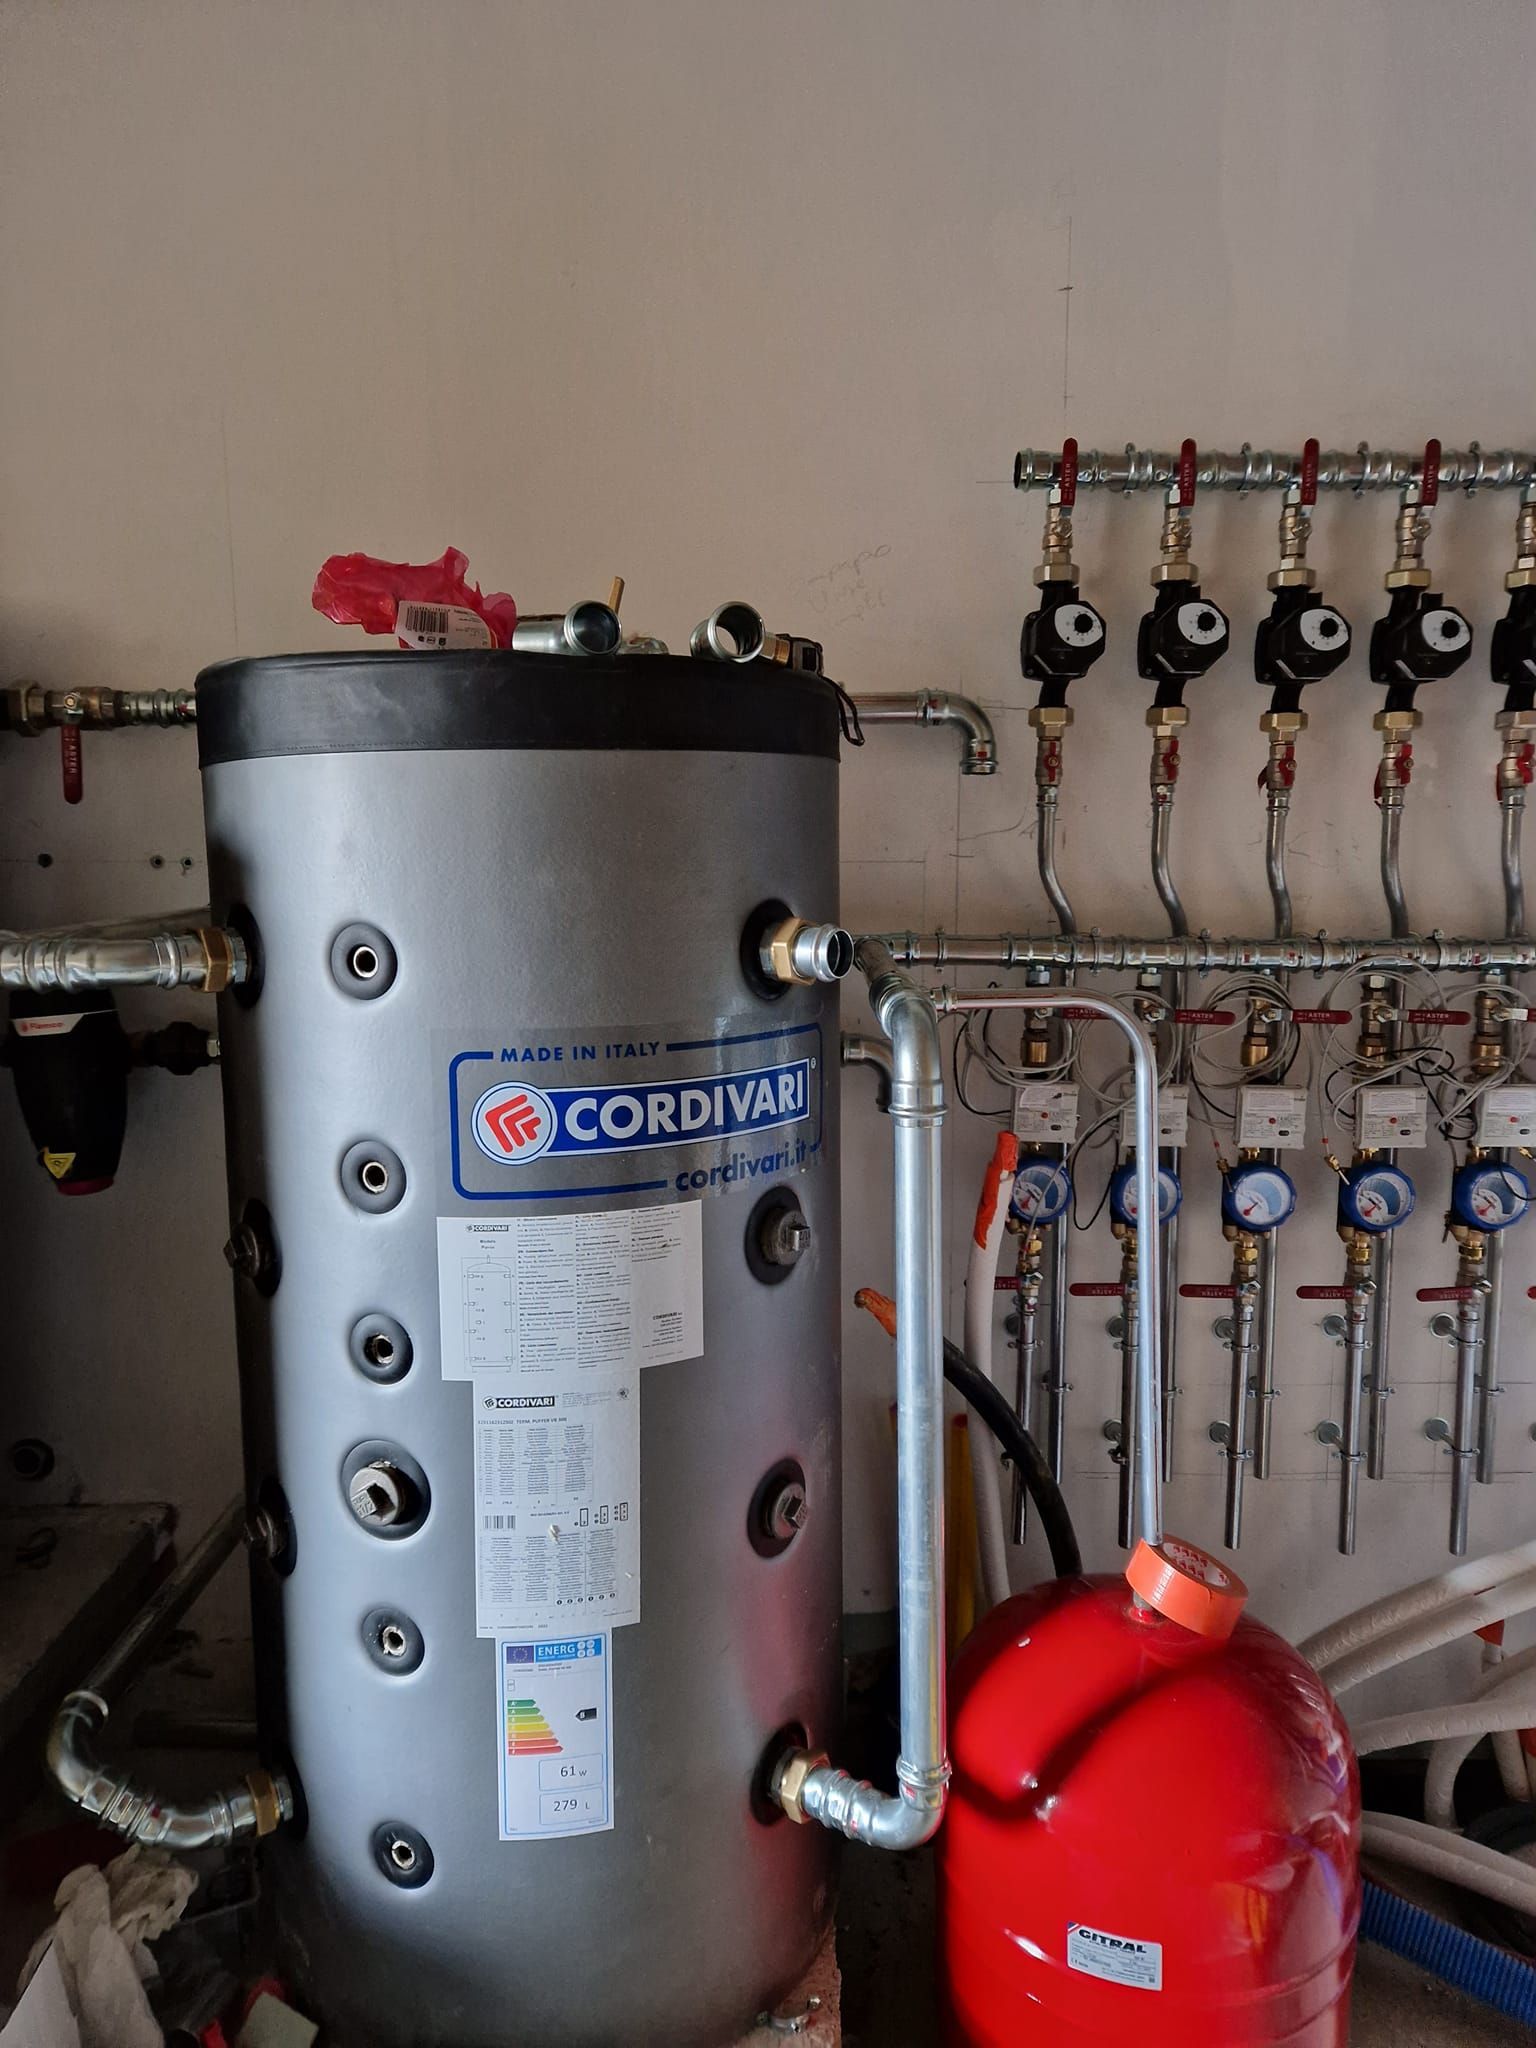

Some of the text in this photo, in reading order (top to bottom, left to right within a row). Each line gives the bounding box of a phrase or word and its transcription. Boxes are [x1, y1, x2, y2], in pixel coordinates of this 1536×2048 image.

[500, 1042, 660, 1062] MADE IN ITALY
[564, 1070, 804, 1141] CORDIVARI
[675, 1142, 807, 1192] cordivari.it
[498, 1397, 553, 1408] CORDIVARI
[538, 1645, 575, 1656] ENERG
[561, 1765, 576, 1777] 61
[553, 1799, 577, 1812] 279
[1079, 1929, 1147, 1953] GITRAL
